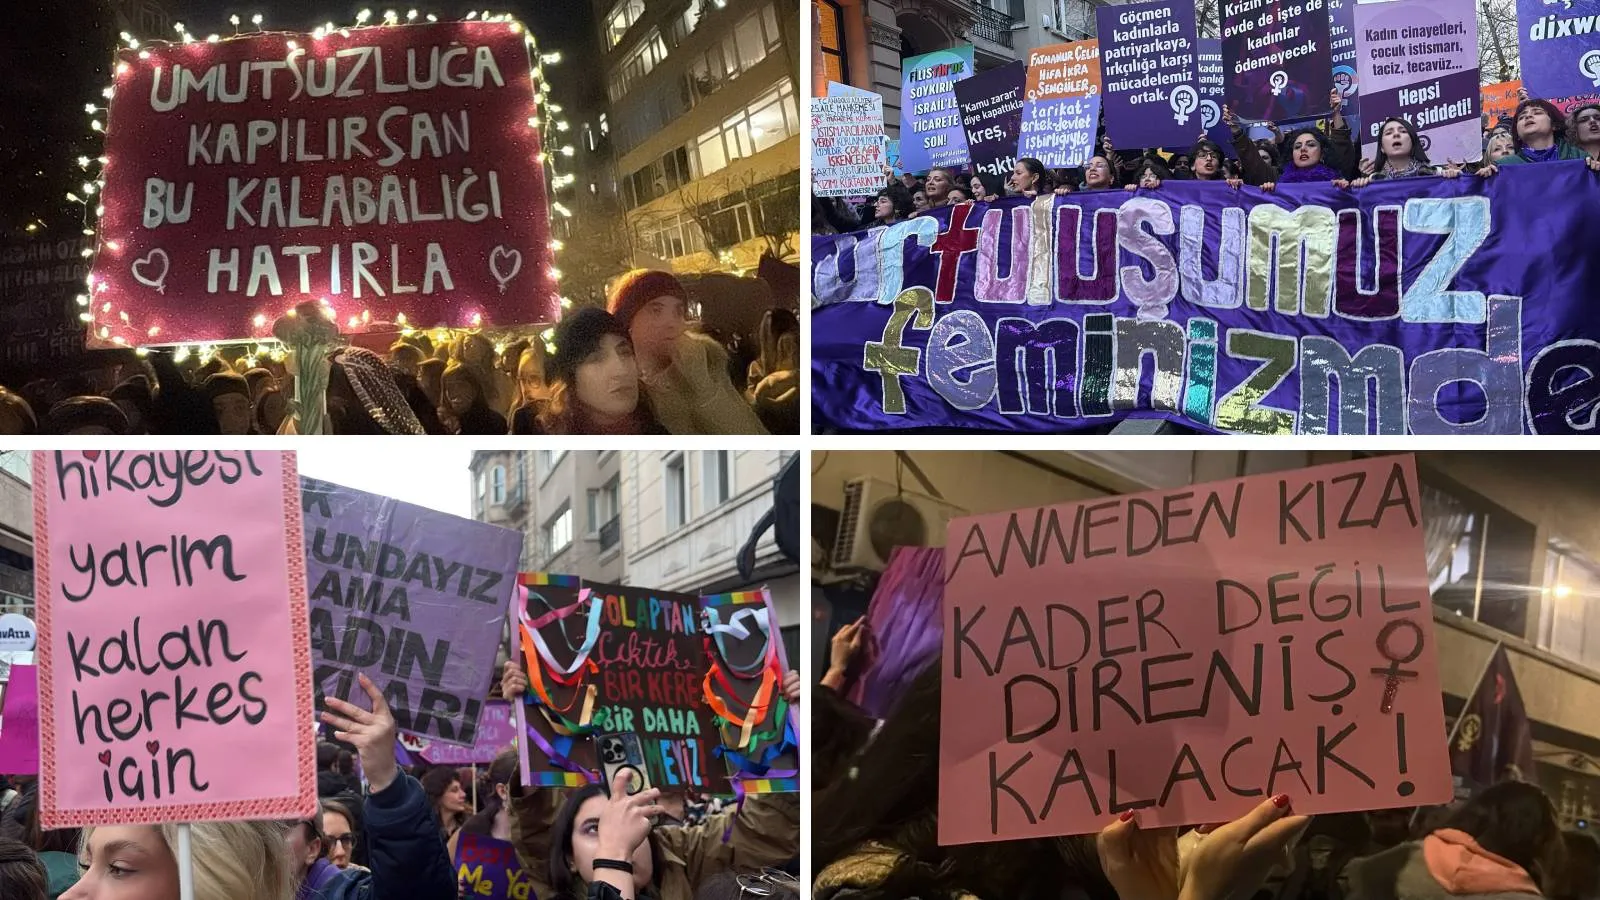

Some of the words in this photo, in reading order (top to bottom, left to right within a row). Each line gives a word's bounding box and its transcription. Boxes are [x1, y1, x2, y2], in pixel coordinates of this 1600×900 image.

[1119, 7, 1171, 25] Göçmen
[1224, 18, 1254, 38] evde
[1258, 13, 1274, 28] de
[1277, 4, 1302, 24] işte
[1305, 0, 1322, 12] de
[1530, 14, 1600, 41] dixw
[1113, 20, 1180, 43] kadınlarla
[1247, 25, 1300, 51] kadınlar
[1330, 26, 1348, 36] tır.
[1365, 27, 1398, 42] Kadın
[1401, 21, 1467, 39] cinayetleri,
[1105, 37, 1191, 63] patriyarkaya,
[1234, 39, 1317, 74] ödemeyecek
[1370, 44, 1406, 61] çocuk
[1408, 41, 1463, 56] istismarı,
[150, 41, 505, 113] UMUTSUZLUĞA
[1106, 57, 1157, 77] ırkçılığa
[1160, 53, 1193, 68] karşı
[1372, 62, 1404, 76] taciz,
[1407, 58, 1463, 74] tecavüz...
[1036, 79, 1089, 98] ŞENGÜLER
[1108, 69, 1193, 93] mücadelemiz
[1398, 81, 1441, 107] Hepsi
[1130, 88, 1169, 104] ortak.
[912, 114, 960, 133] TİCARETE
[963, 114, 982, 126] diye
[1370, 114, 1413, 137] erk
[1416, 97, 1472, 127] şiddeti!
[187, 106, 469, 167] KAPILIRSAN
[923, 134, 948, 150] SON!
[967, 124, 1007, 145] kreş,
[143, 177, 194, 229] BU
[226, 169, 503, 230] KALABALIĞI
[206, 241, 455, 299] HATIRLA
[811, 193, 1491, 323] urtuluşumuz
[946, 482, 1245, 585] ANNEDEN
[1279, 462, 1419, 544] KIZA
[61, 534, 248, 602] yarım
[311, 571, 412, 623] AMA
[600, 594, 696, 636] OLAPTAN
[953, 588, 1182, 679] KADER
[1216, 560, 1422, 636] DEĞİL
[0, 627, 31, 639] VAZZA
[67, 615, 249, 682] kalan
[604, 664, 641, 702] BİR
[646, 670, 699, 709] KERE
[72, 670, 269, 745] herkes
[602, 704, 635, 732] BİR
[642, 706, 700, 736] DAHA
